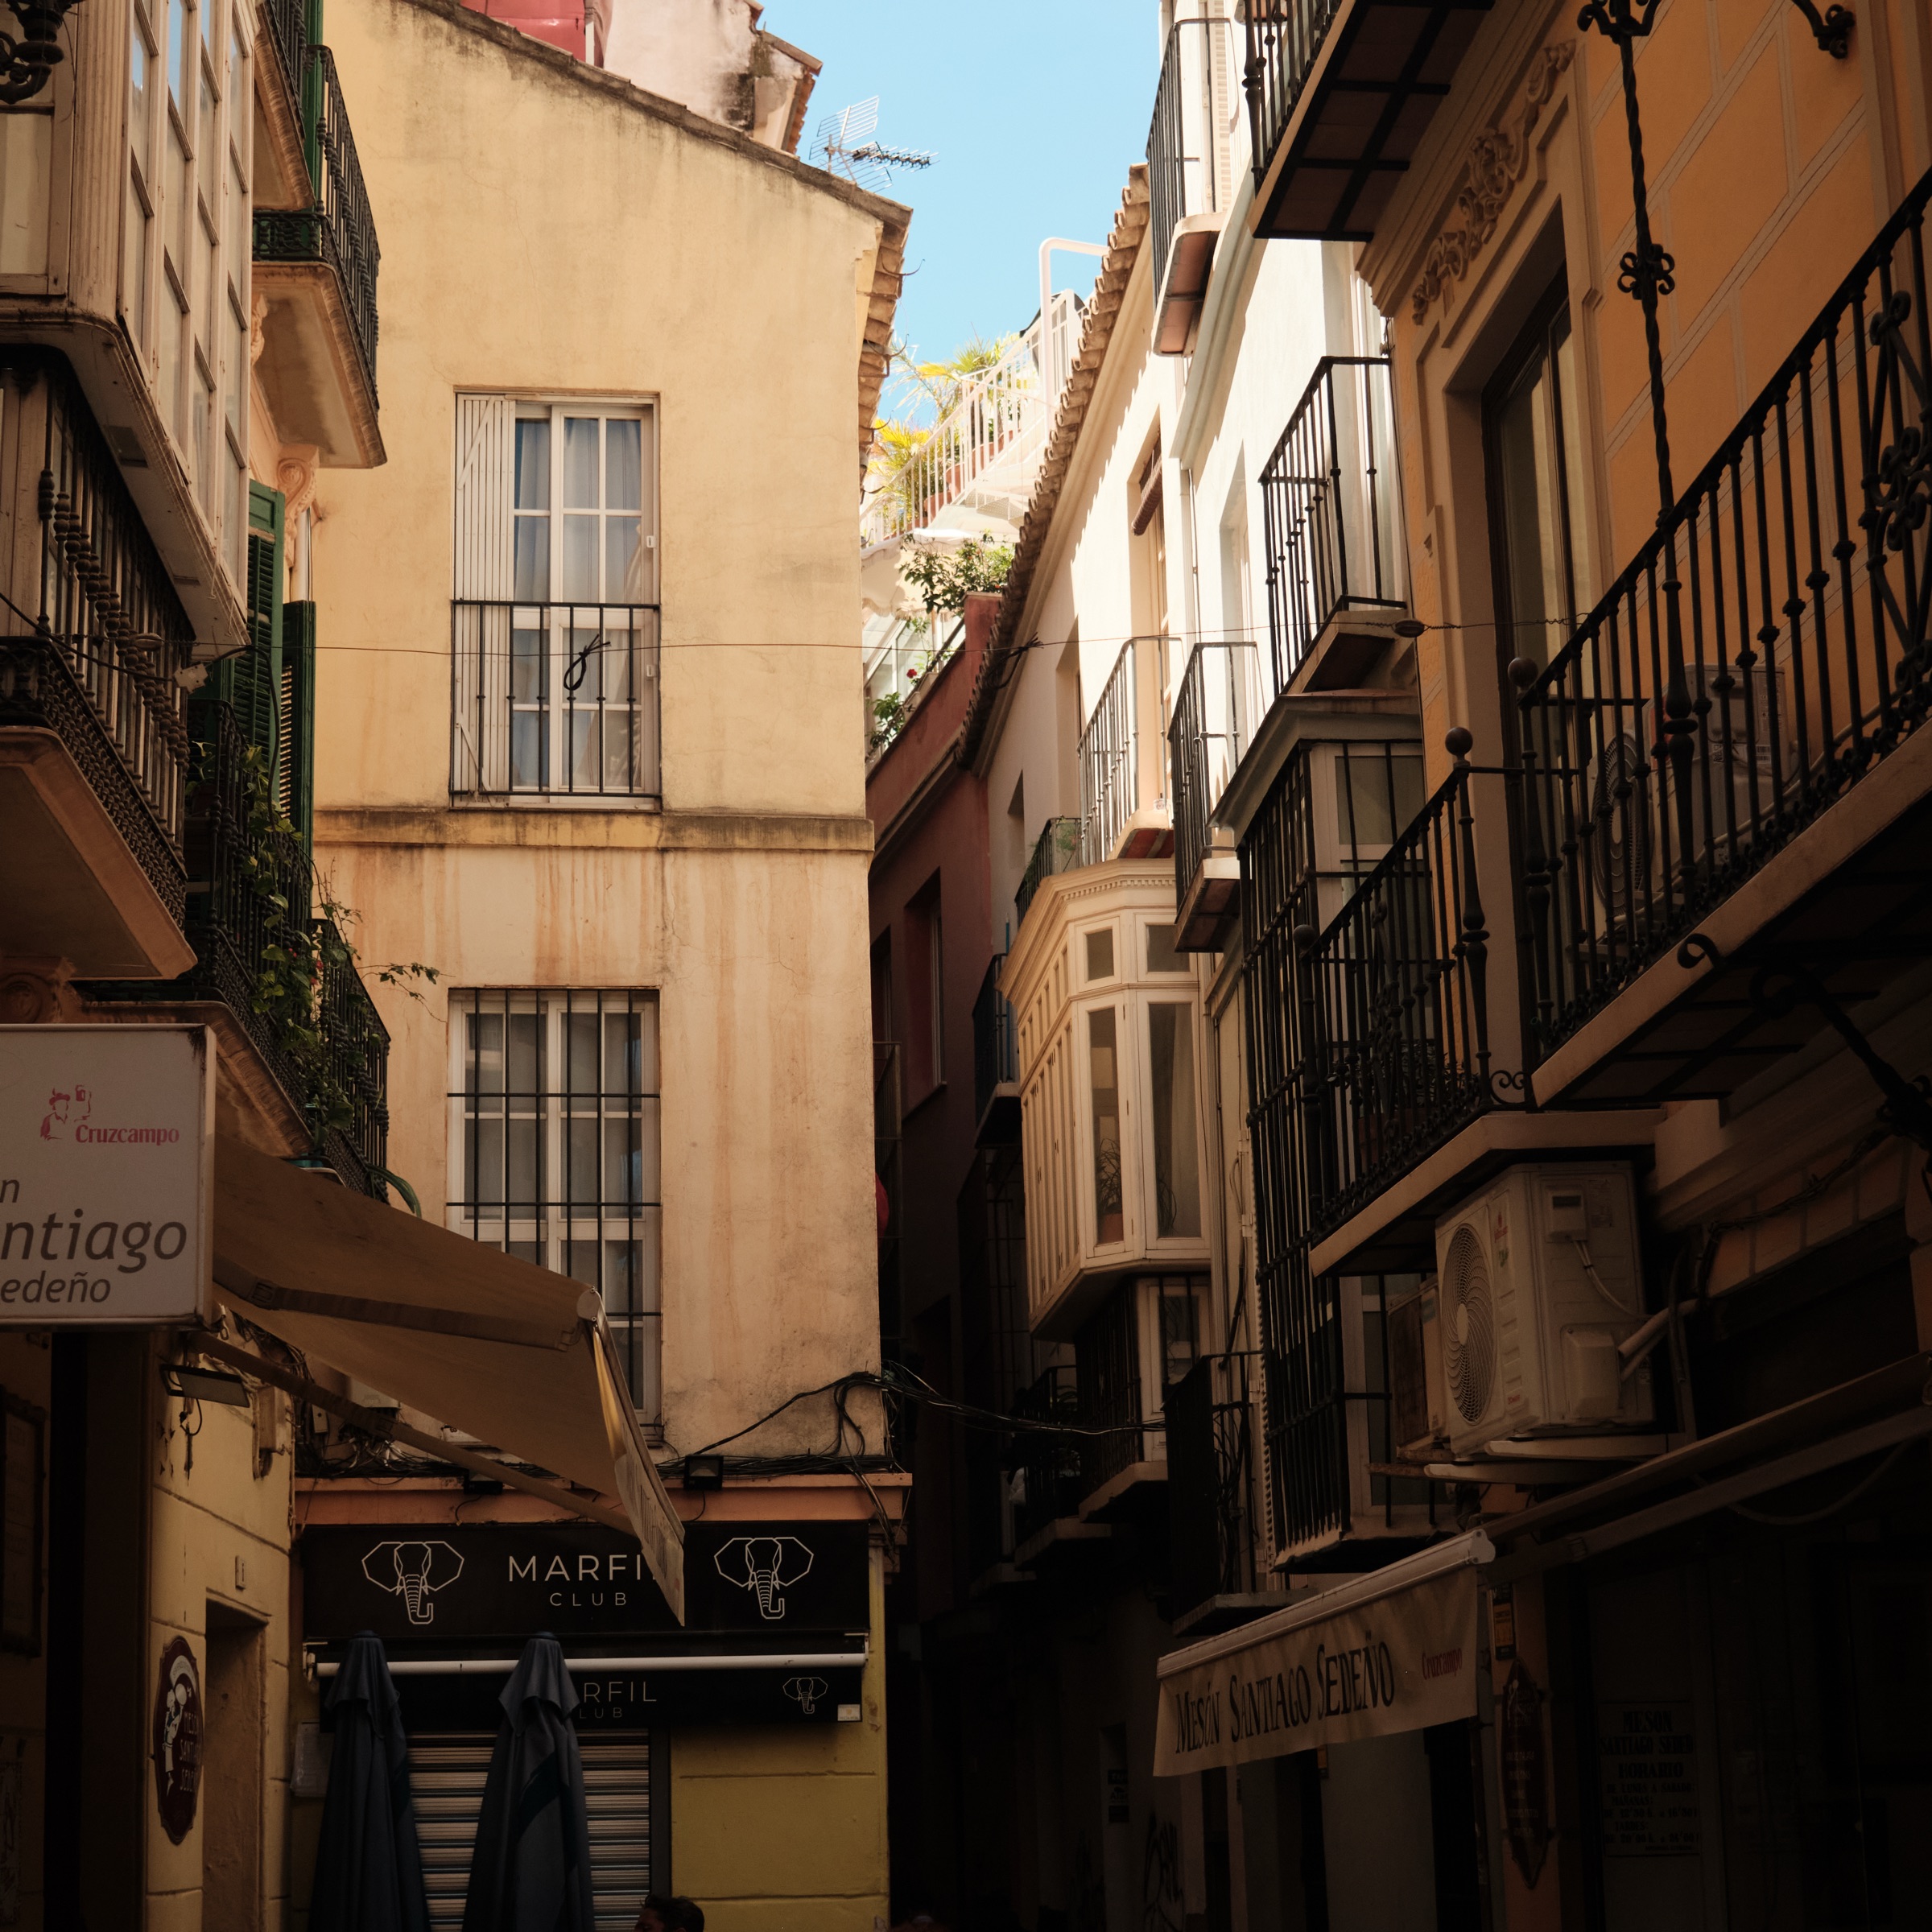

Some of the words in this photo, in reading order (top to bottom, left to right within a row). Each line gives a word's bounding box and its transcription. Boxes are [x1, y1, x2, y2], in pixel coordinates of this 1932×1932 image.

[76, 1125, 180, 1146] Cruzcampo
[0, 1208, 188, 1274] ntiago
[0, 1270, 111, 1303] edeño
[509, 1554, 656, 1582] MARFI
[550, 1591, 627, 1607] CLUB
[1422, 1648, 1463, 1680] Cruzcampo
[584, 1681, 657, 1703] RFIL
[1229, 1664, 1311, 1743] SANTIAGO
[1316, 1630, 1395, 1721] SEDEÑO
[580, 1707, 623, 1719] LUB
[1623, 1711, 1674, 1733] MESON
